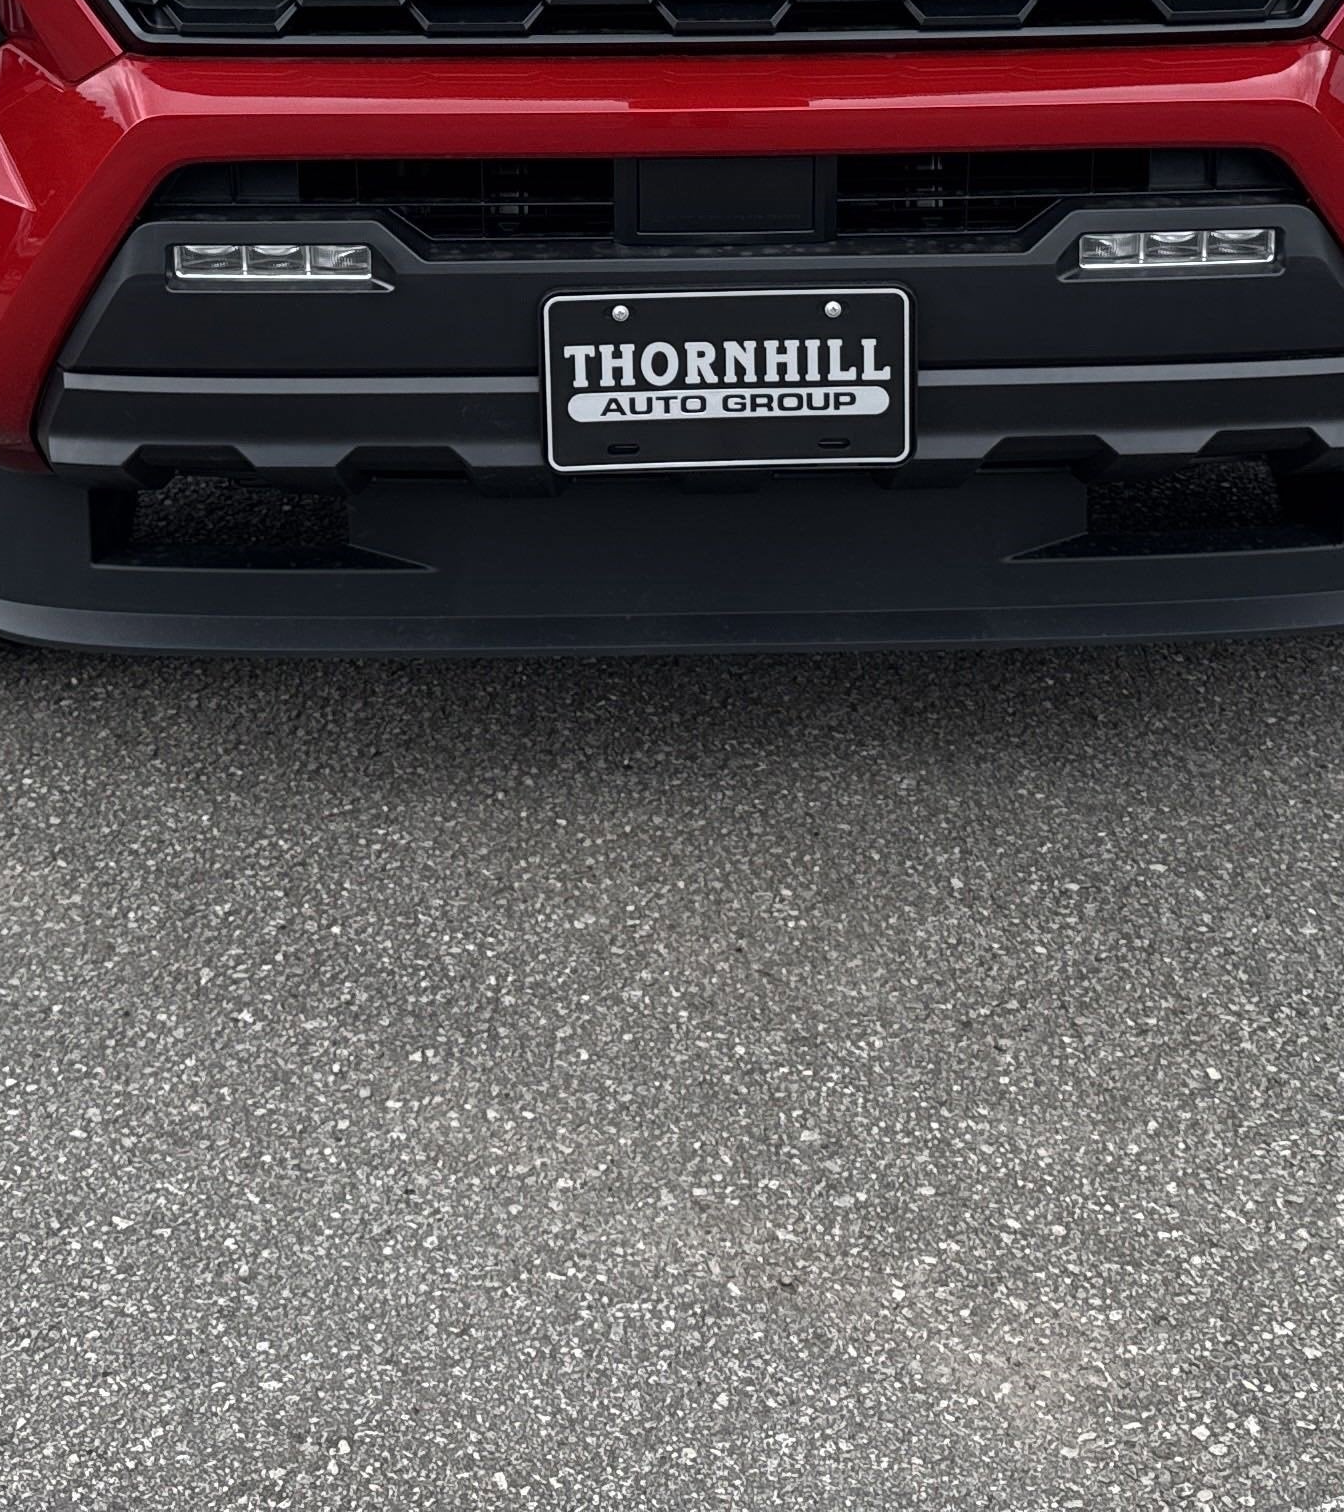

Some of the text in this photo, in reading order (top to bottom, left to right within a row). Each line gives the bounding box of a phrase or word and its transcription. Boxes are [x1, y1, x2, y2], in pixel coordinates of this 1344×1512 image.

[563, 338, 892, 387] THORNHILL
[600, 391, 858, 416] AUTO GROUP
